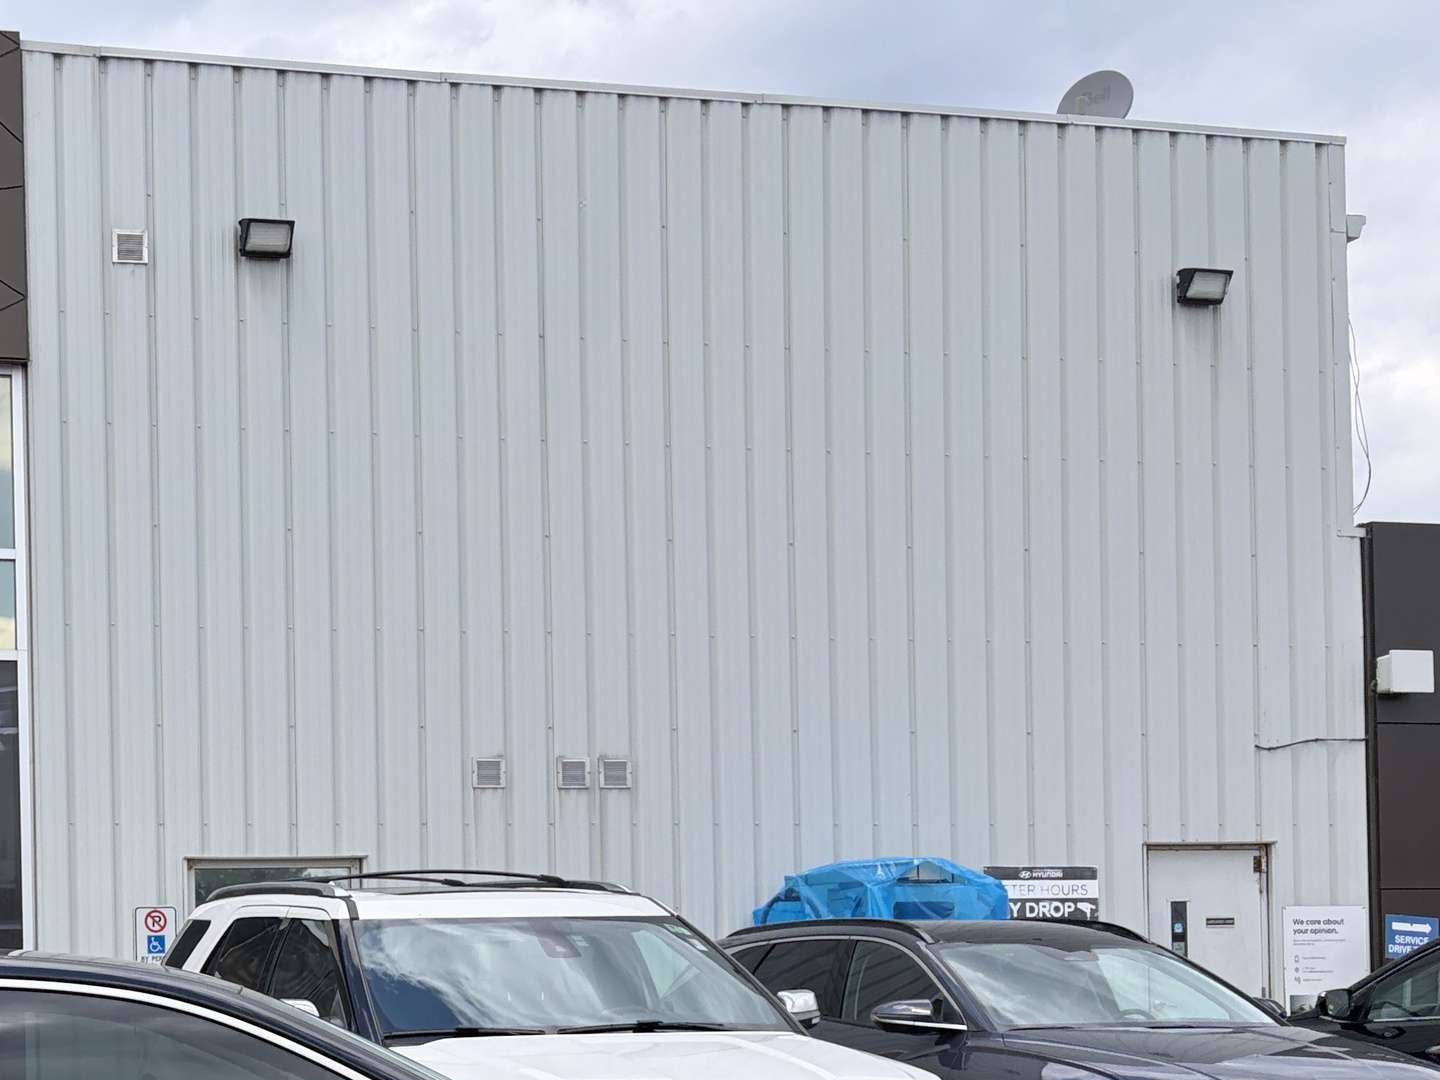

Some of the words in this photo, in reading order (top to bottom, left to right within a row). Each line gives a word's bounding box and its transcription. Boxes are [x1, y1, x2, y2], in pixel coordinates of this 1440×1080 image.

[1004, 884, 1035, 896] TER
[1041, 884, 1088, 896] HOURS
[1026, 902, 1075, 918] DROP
[1322, 918, 1344, 926] about
[1292, 928, 1308, 936] your
